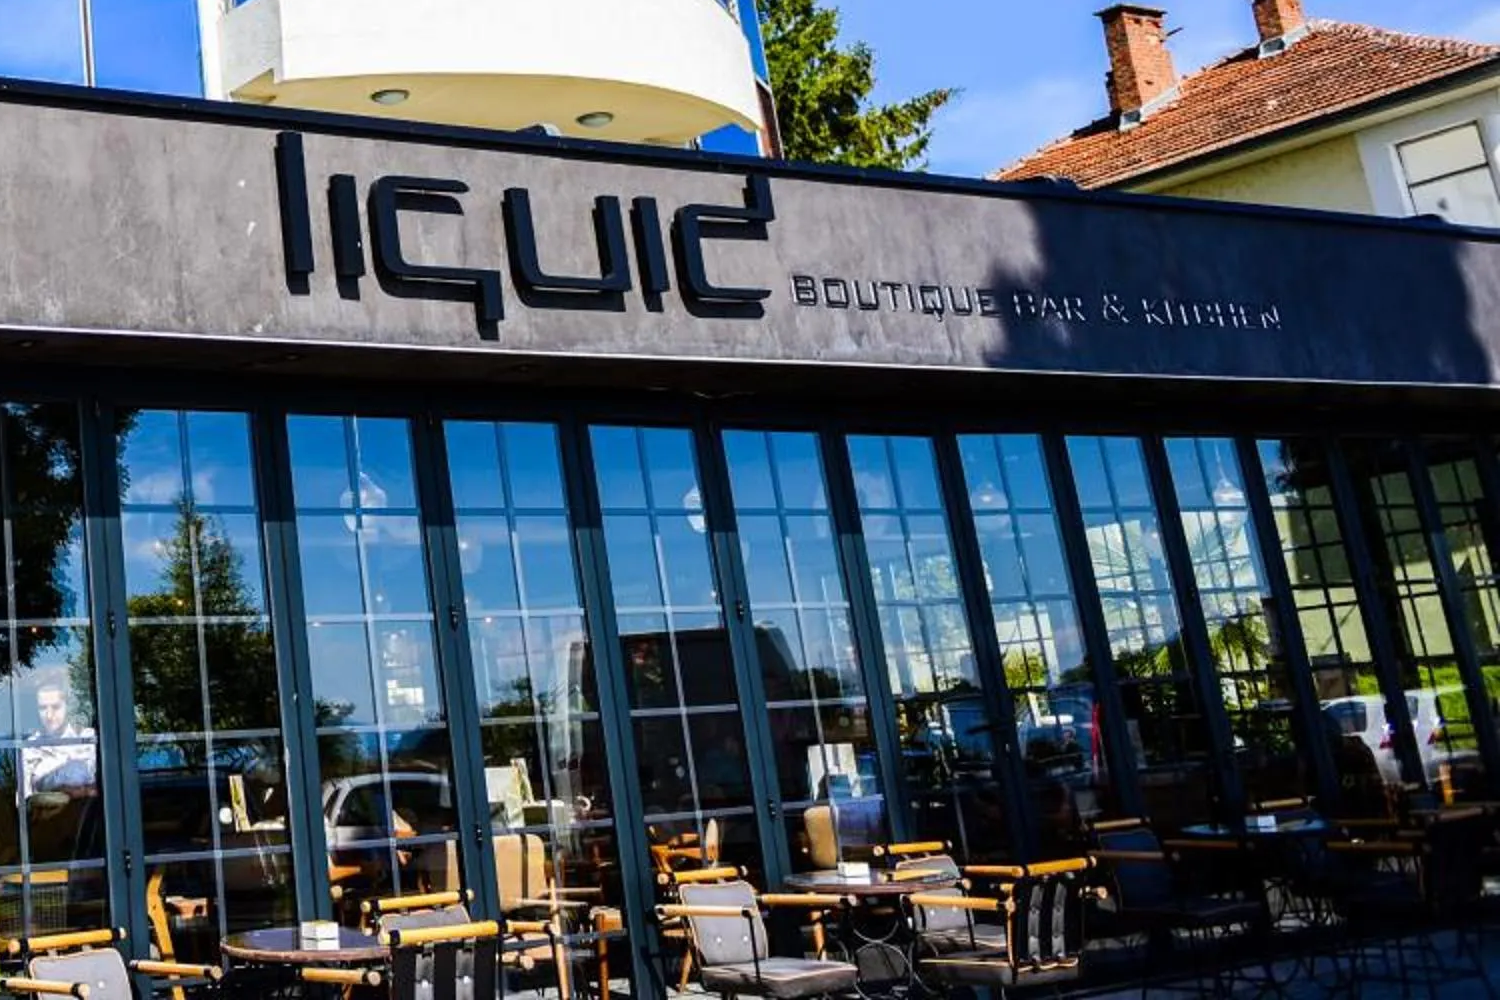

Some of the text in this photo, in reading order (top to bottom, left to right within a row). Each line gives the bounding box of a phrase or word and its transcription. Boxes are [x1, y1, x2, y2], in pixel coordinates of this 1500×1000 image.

[791, 275, 1283, 330] BOUTIQUE BAR & KITCHEN
